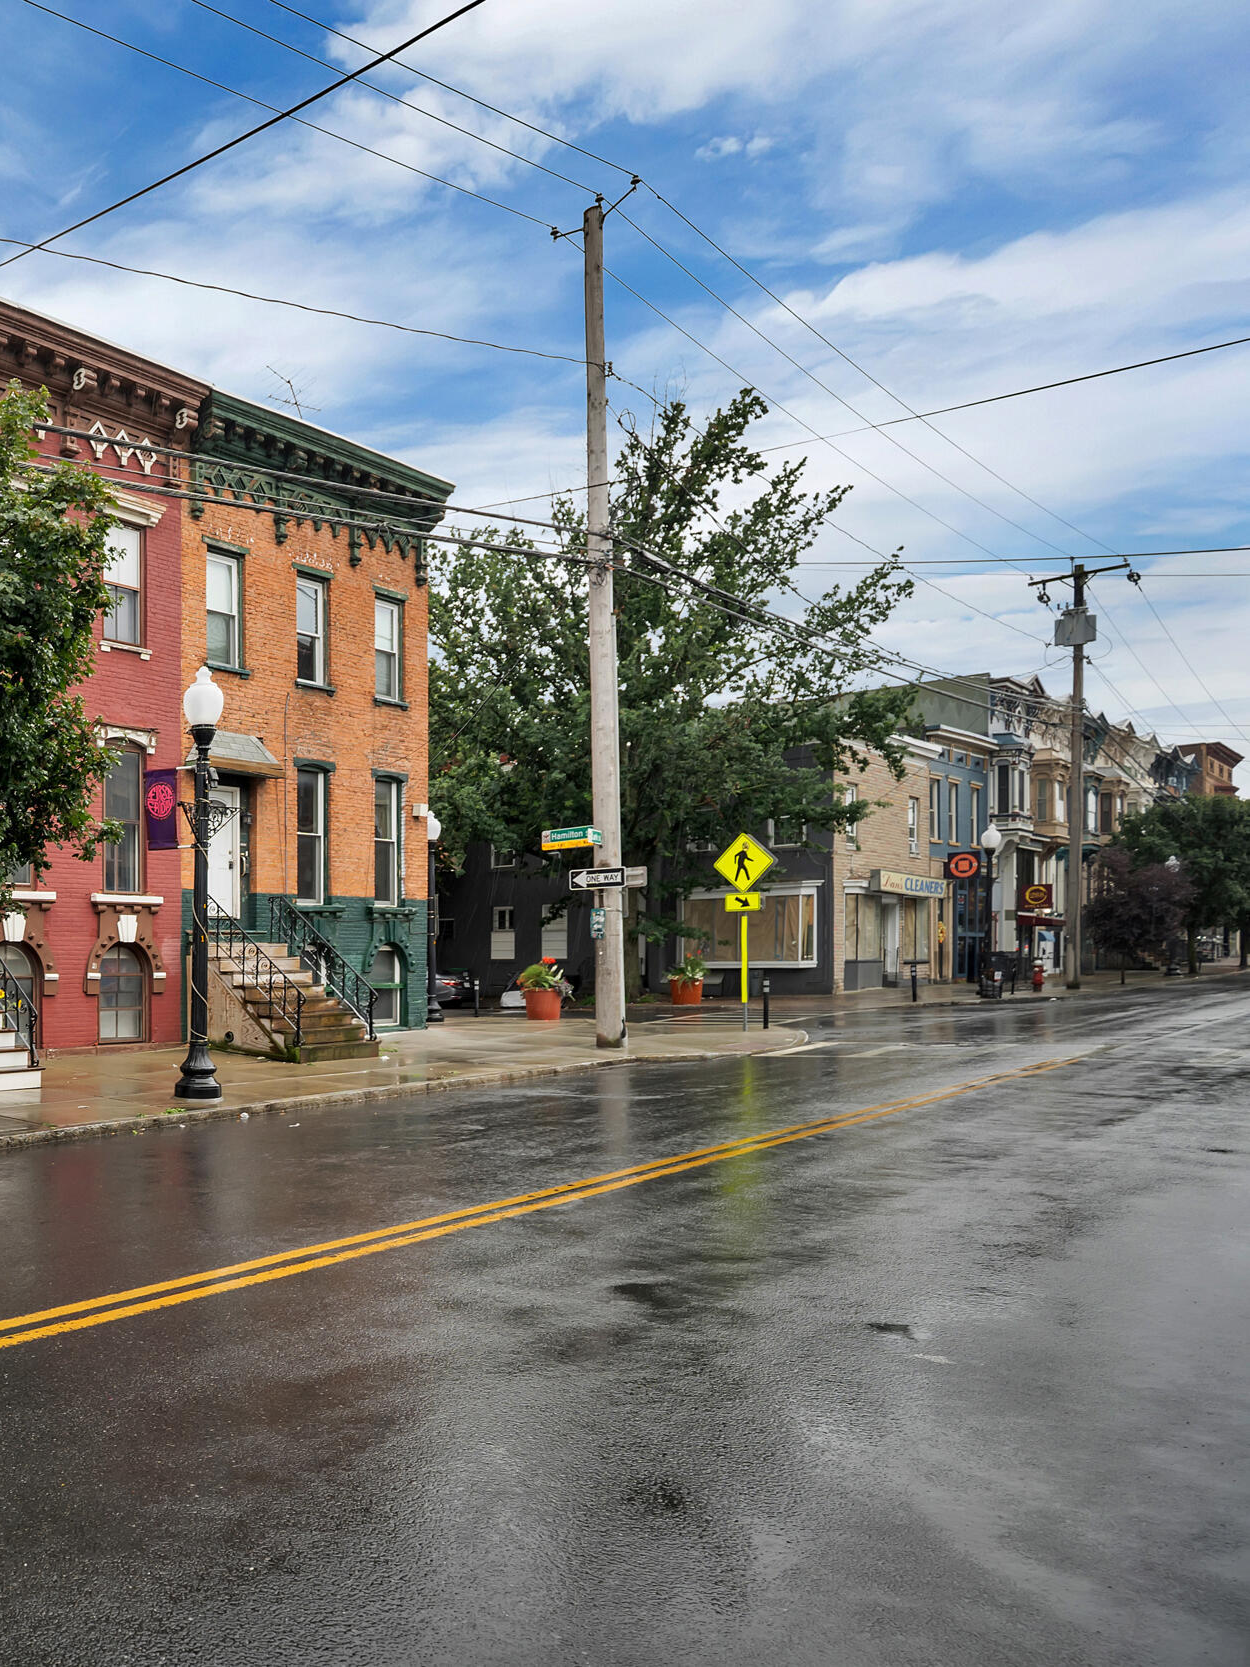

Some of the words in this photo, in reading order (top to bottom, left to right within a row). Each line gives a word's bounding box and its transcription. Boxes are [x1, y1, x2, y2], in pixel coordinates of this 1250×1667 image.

[551, 830, 583, 841] Hamilton
[586, 875, 601, 883] ONE
[604, 873, 619, 881] WAY
[904, 877, 945, 895] CLEANERS
